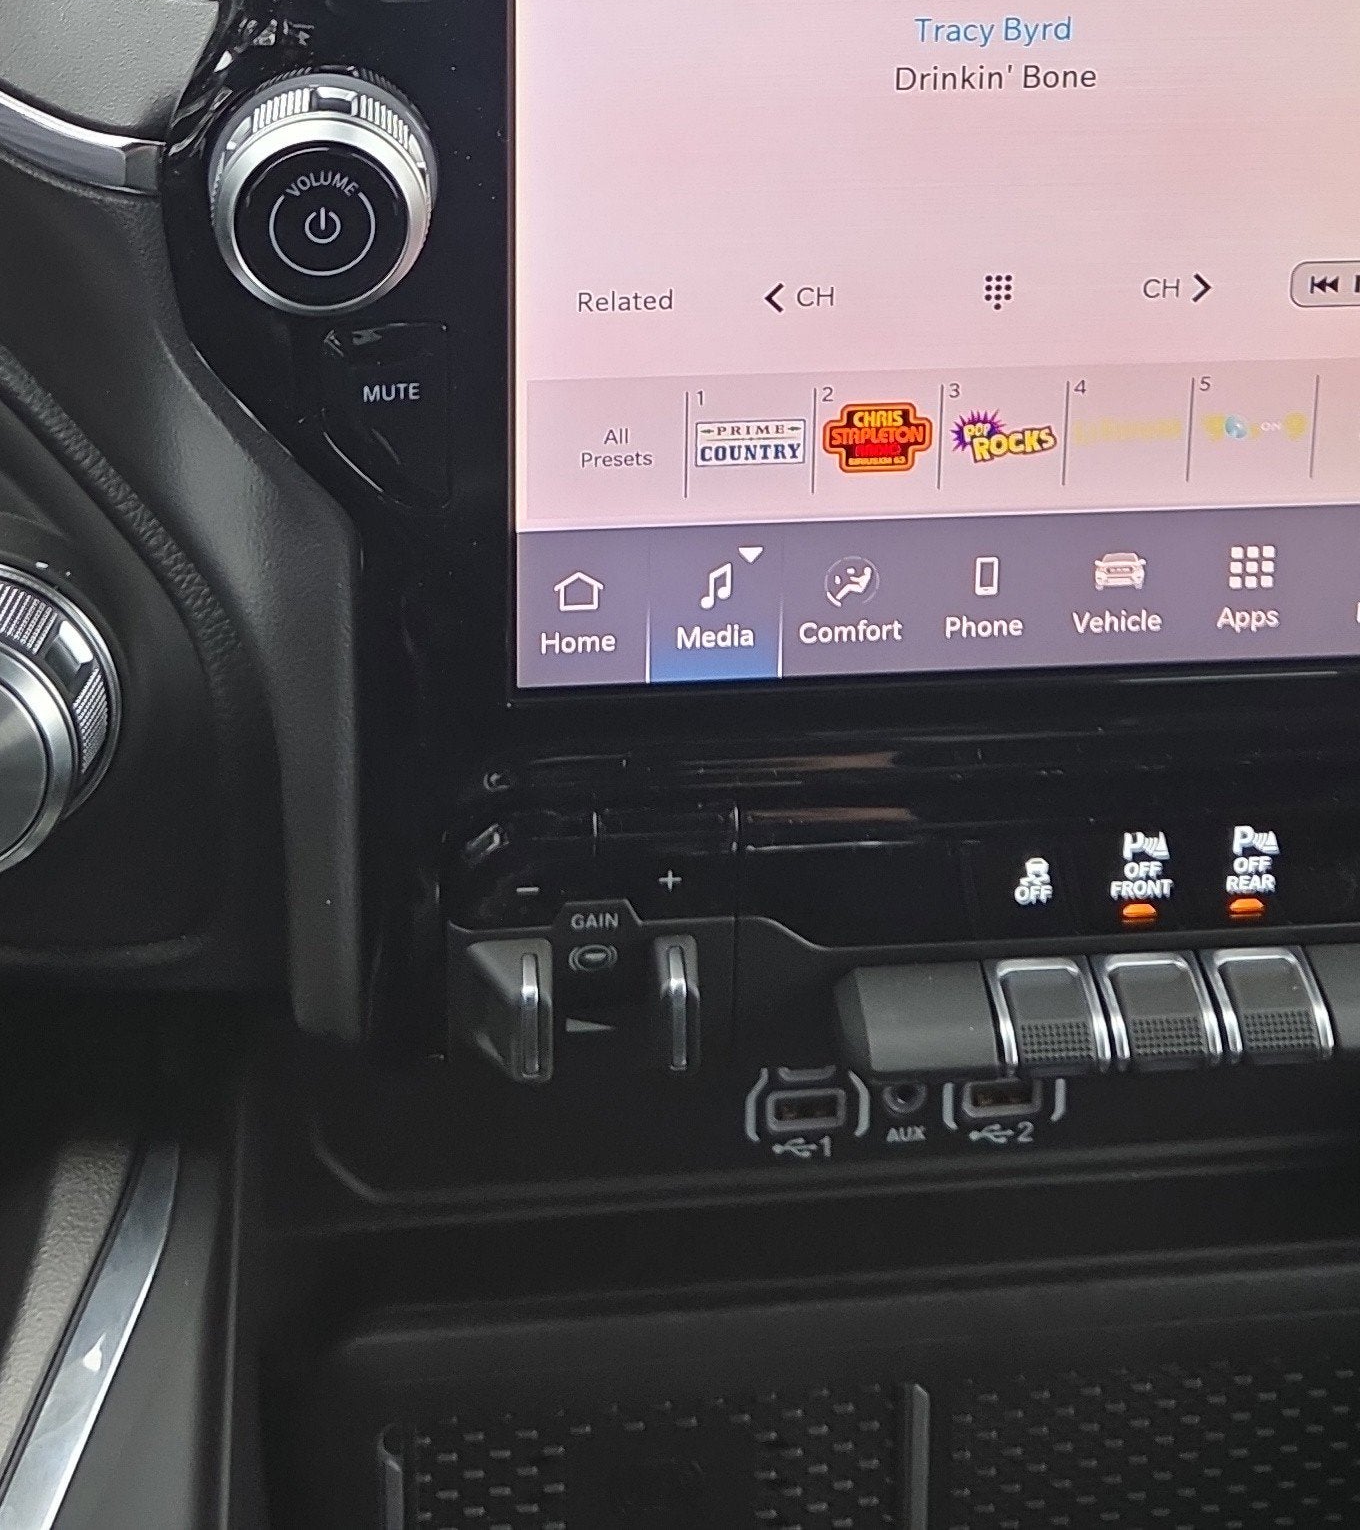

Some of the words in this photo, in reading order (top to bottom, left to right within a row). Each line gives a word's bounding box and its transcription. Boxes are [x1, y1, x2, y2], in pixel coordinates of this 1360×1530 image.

[914, 17, 995, 48] Tracy
[1003, 15, 1072, 47] Byrd
[895, 64, 1013, 91] Drinkin'
[1022, 64, 1097, 89] Bone
[285, 172, 360, 200] VOLUME
[796, 285, 836, 308] CH
[1142, 276, 1181, 299] CH
[577, 287, 674, 313] Related
[362, 382, 421, 402] MUTE
[948, 382, 961, 399] 3
[1073, 379, 1087, 396] 4
[1198, 375, 1212, 392] 5
[695, 390, 705, 406] 1
[821, 386, 834, 403] 2
[852, 409, 904, 429] CHRIS
[603, 427, 630, 446] All
[716, 423, 786, 437] PRIME
[830, 424, 924, 447] STAPLETON
[963, 423, 991, 440] POP
[699, 442, 802, 463] COUNTRY
[971, 425, 1058, 463] ROCKS
[580, 450, 654, 470] Presets
[944, 615, 1024, 638] Phone
[1072, 608, 1163, 635] Vehicle
[1216, 607, 1280, 631] Apps
[676, 624, 755, 649] Media
[798, 618, 903, 644] Comfort
[541, 632, 617, 654] Home
[1123, 861, 1163, 880] OFF
[1233, 856, 1272, 875] OFF
[1109, 878, 1174, 900] FRONT
[1225, 873, 1276, 894] REAR
[1014, 884, 1053, 905] OFF
[570, 912, 619, 931] GAIN
[886, 1125, 926, 1142] AUX
[1017, 1121, 1034, 1143] 2
[821, 1135, 832, 1157] 1
